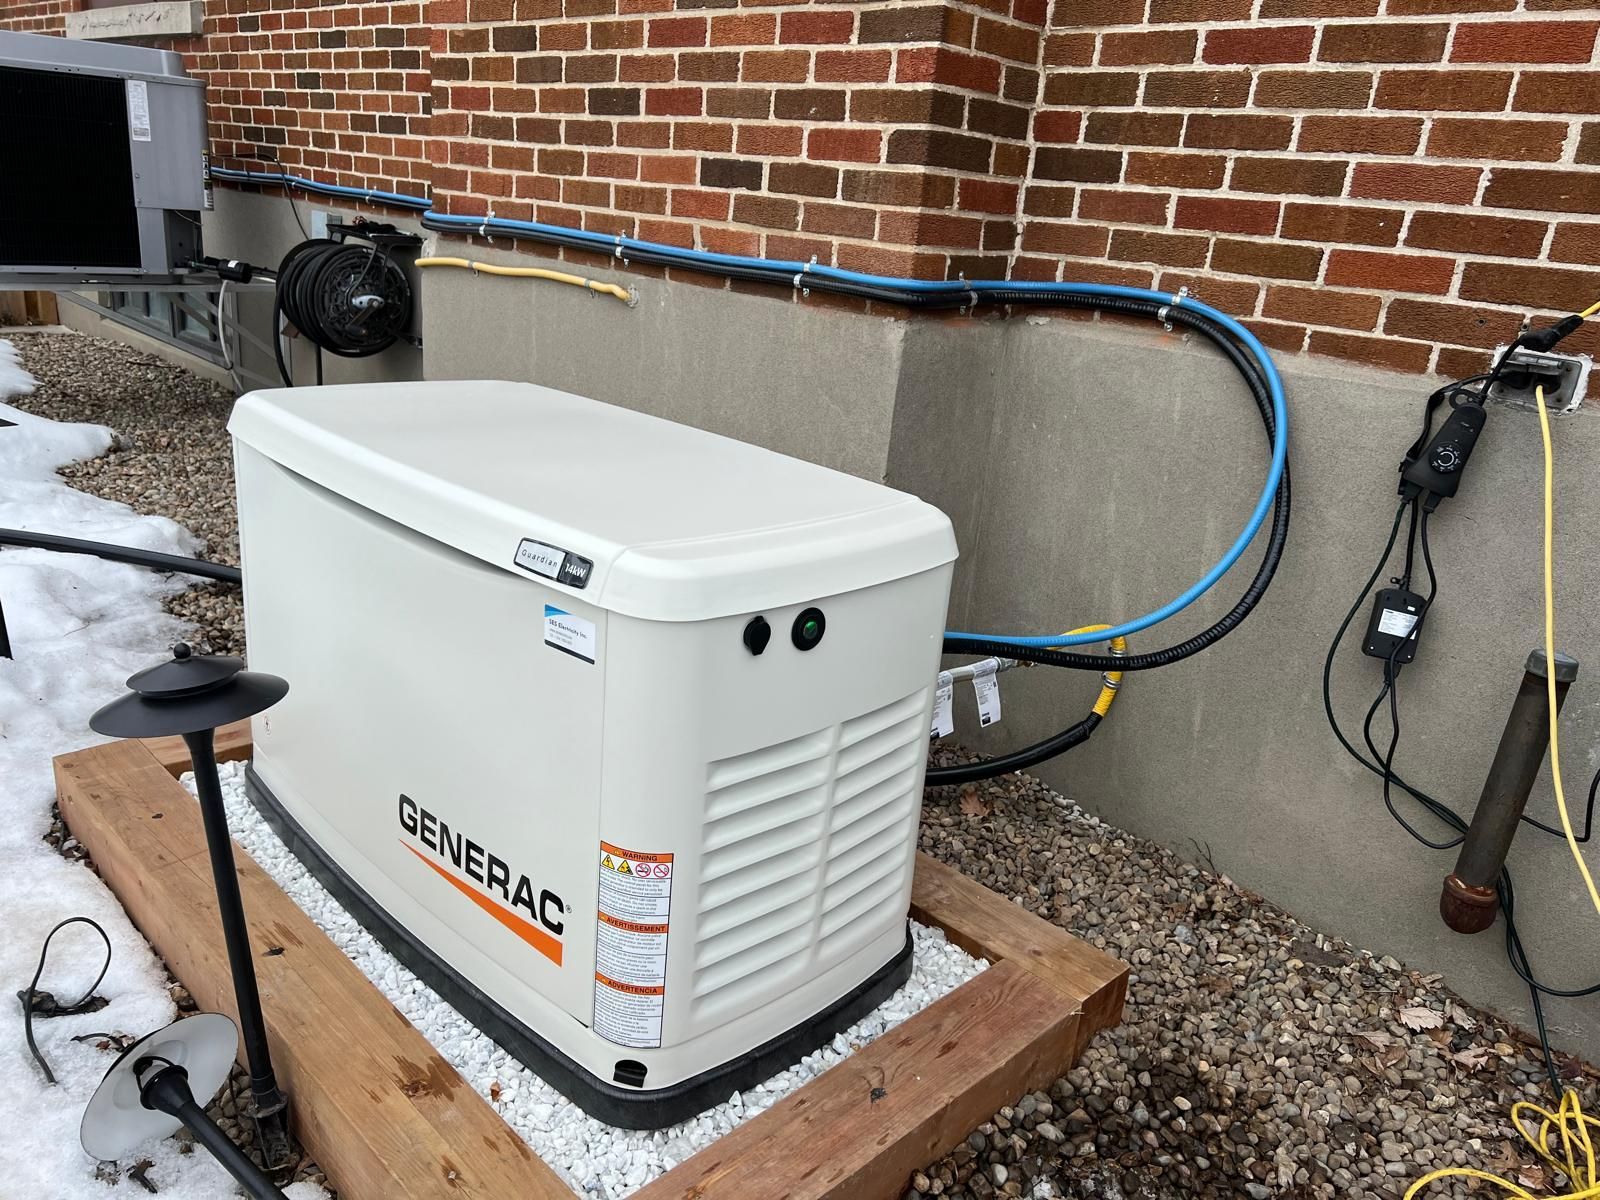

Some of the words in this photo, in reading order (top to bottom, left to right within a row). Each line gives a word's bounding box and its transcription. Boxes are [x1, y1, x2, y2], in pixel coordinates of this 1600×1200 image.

[521, 549, 558, 568] Guardian
[565, 563, 586, 578] 14kW
[558, 622, 578, 636] Electricity
[622, 851, 658, 862] WARNING
[398, 793, 565, 936] GENERAC
[606, 917, 666, 932] AVERTISSEMENT
[607, 980, 658, 994] ADVERTENCIA
